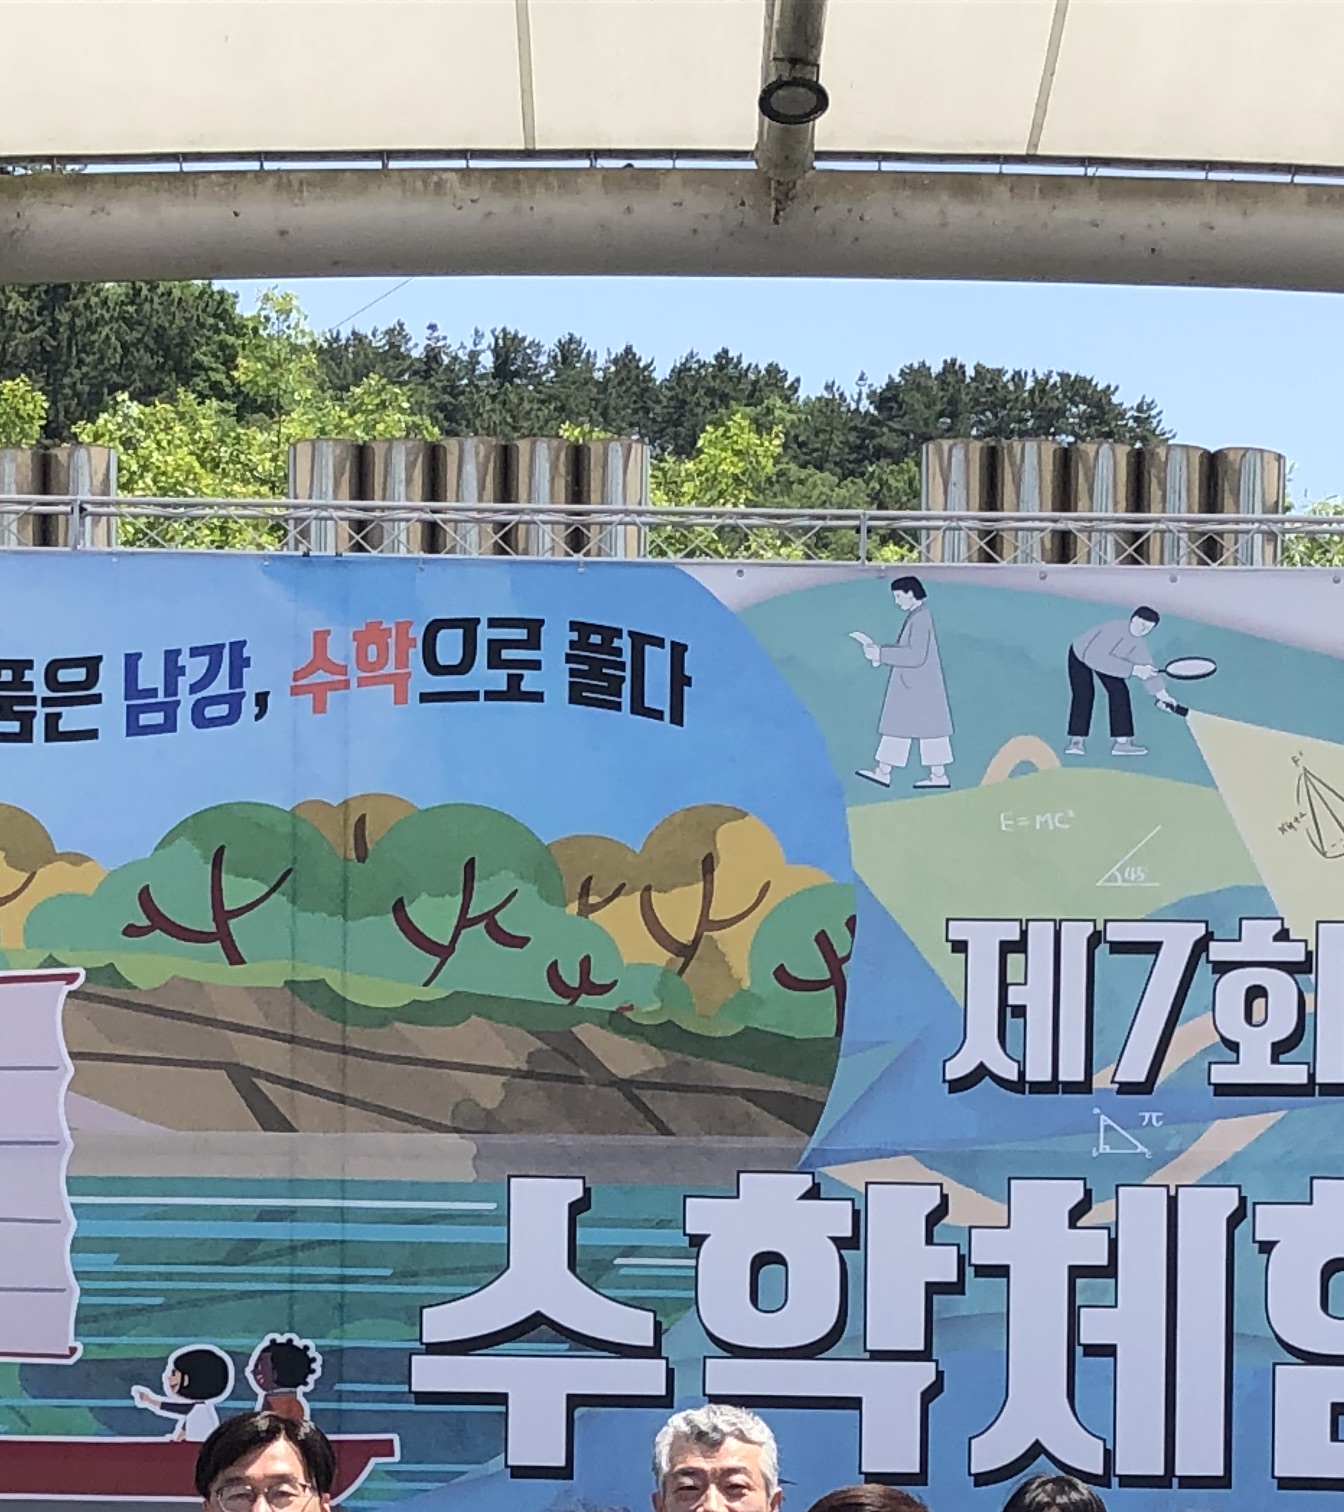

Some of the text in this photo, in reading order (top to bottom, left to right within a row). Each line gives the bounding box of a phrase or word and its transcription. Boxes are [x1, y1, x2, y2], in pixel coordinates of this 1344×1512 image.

[123, 639, 270, 738] 남강,
[289, 617, 546, 715] 수학으로
[566, 619, 692, 729] 풀다
